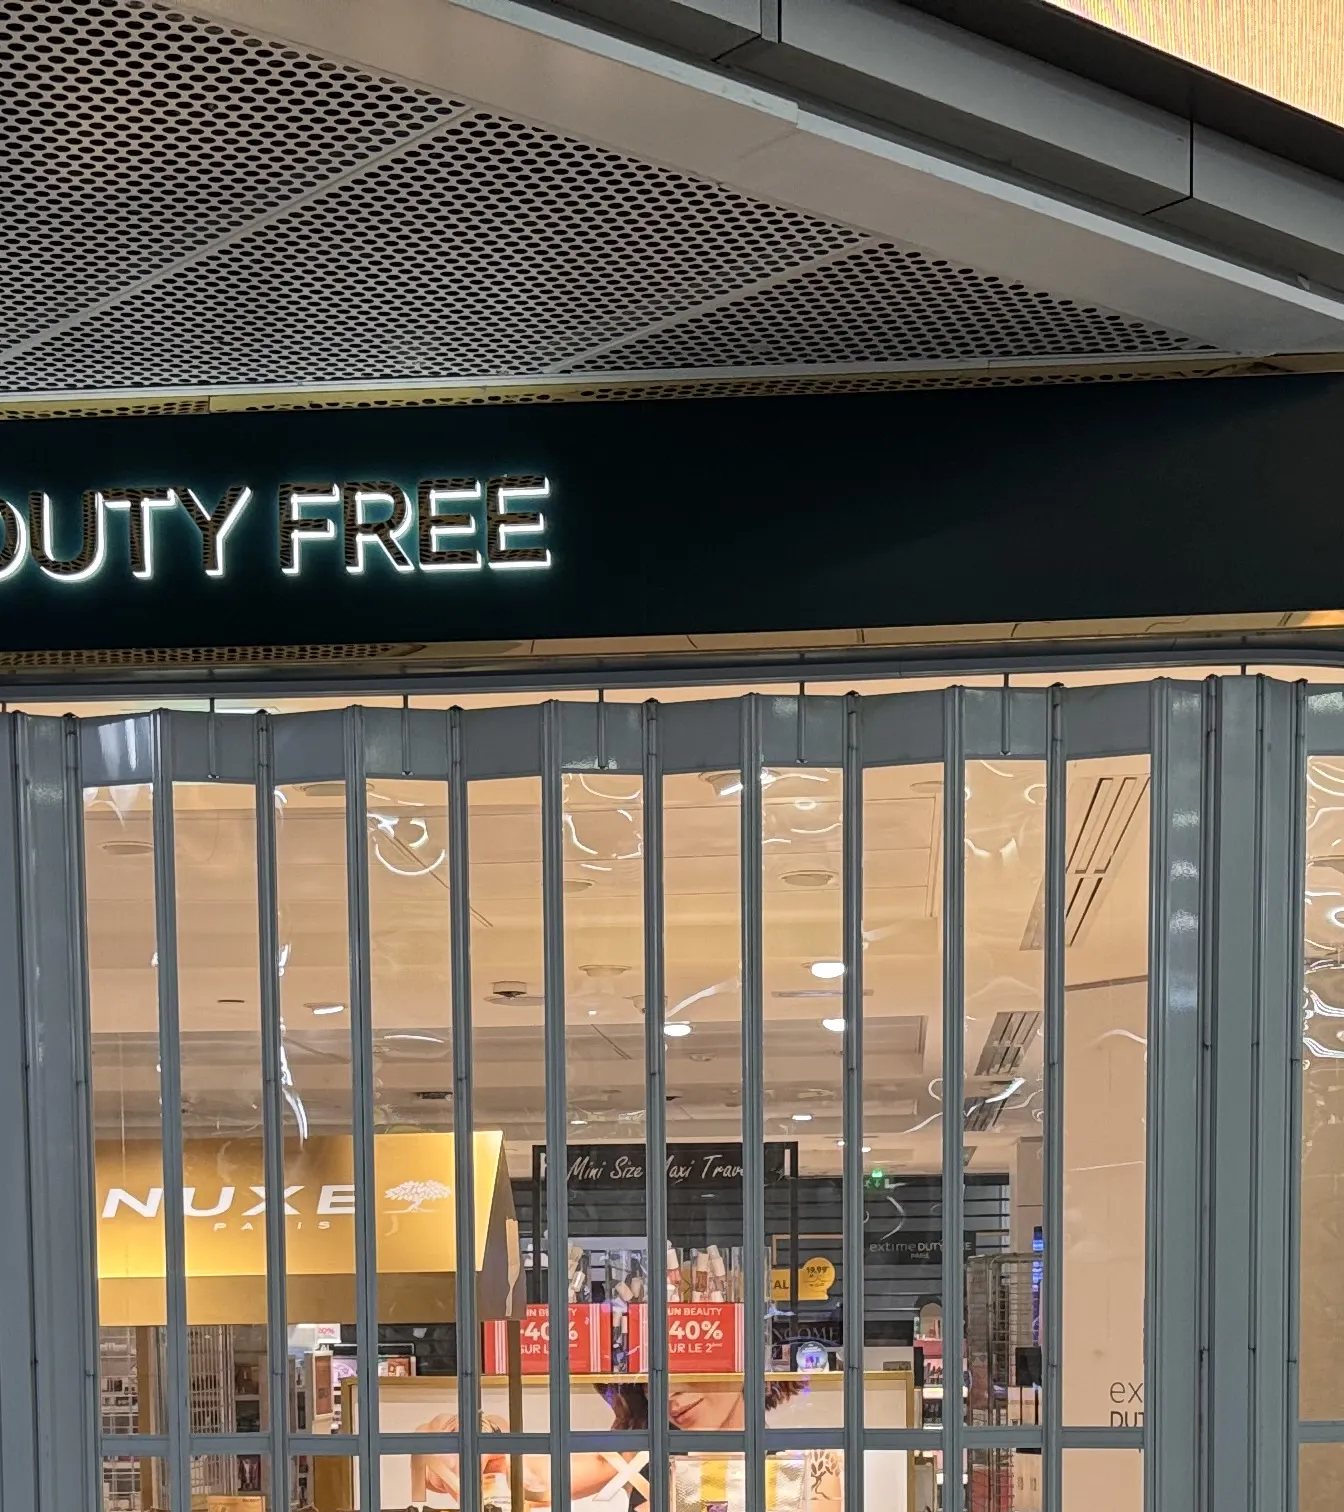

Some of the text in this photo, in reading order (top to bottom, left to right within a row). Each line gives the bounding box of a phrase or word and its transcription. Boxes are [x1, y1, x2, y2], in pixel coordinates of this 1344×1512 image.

[278, 474, 554, 577] FREE
[567, 1156, 606, 1180] Mini
[610, 1155, 644, 1180] Size
[701, 1154, 745, 1180] Trav
[101, 1184, 356, 1218] NUXE
[212, 1221, 331, 1232] PAIS
[667, 1307, 723, 1316] UN BEAUTY
[668, 1343, 686, 1353] UR
[687, 1343, 703, 1353] LE
